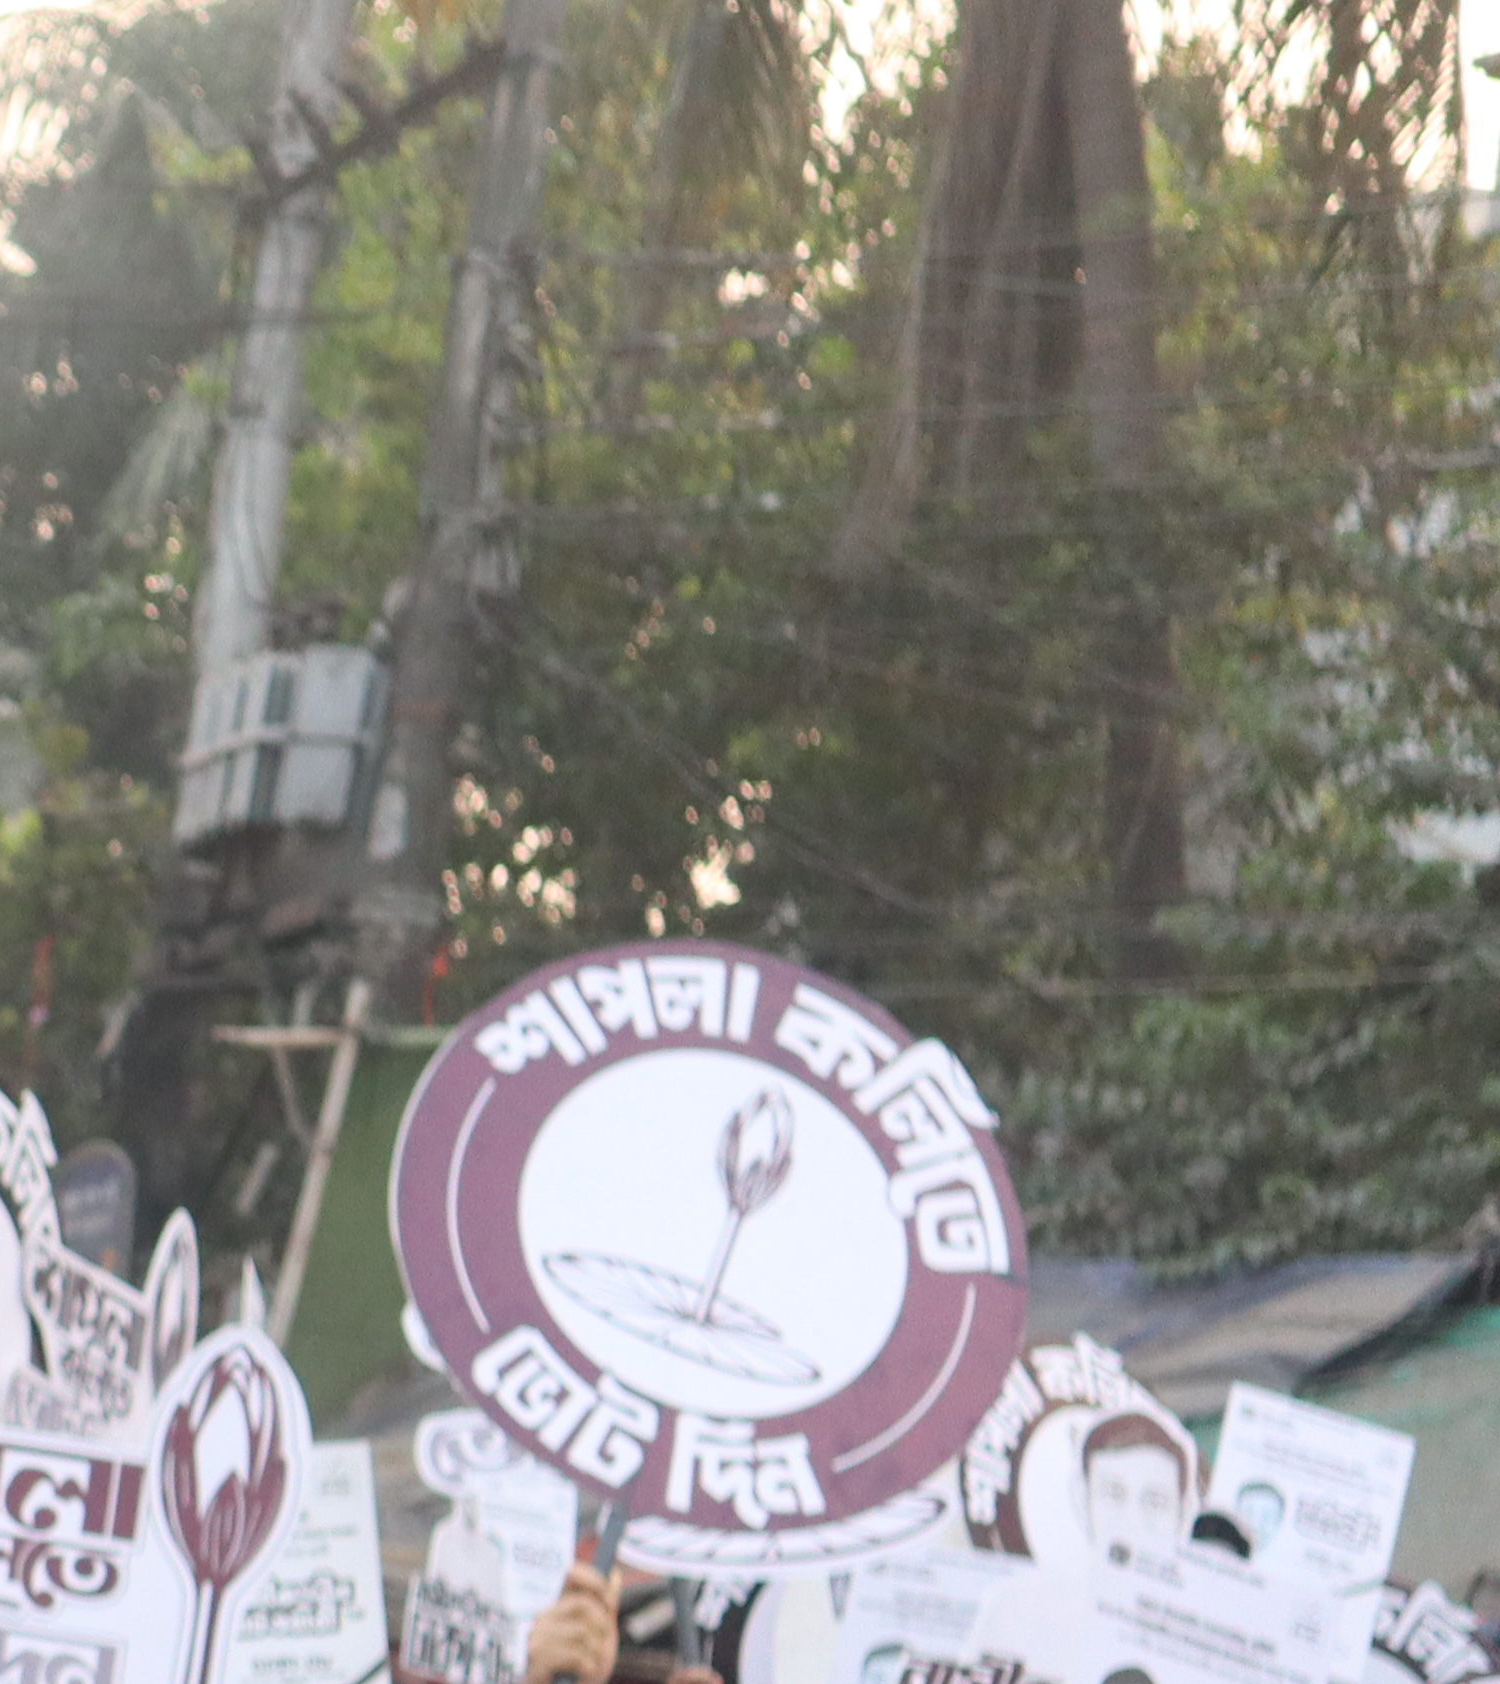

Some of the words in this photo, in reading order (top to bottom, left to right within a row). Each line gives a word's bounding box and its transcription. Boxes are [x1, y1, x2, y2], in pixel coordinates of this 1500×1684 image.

[474, 955, 760, 1074] শাপলা
[775, 981, 1012, 1275] কলিতে
[472, 1325, 660, 1488] ভোট
[664, 1409, 827, 1530] দিন
